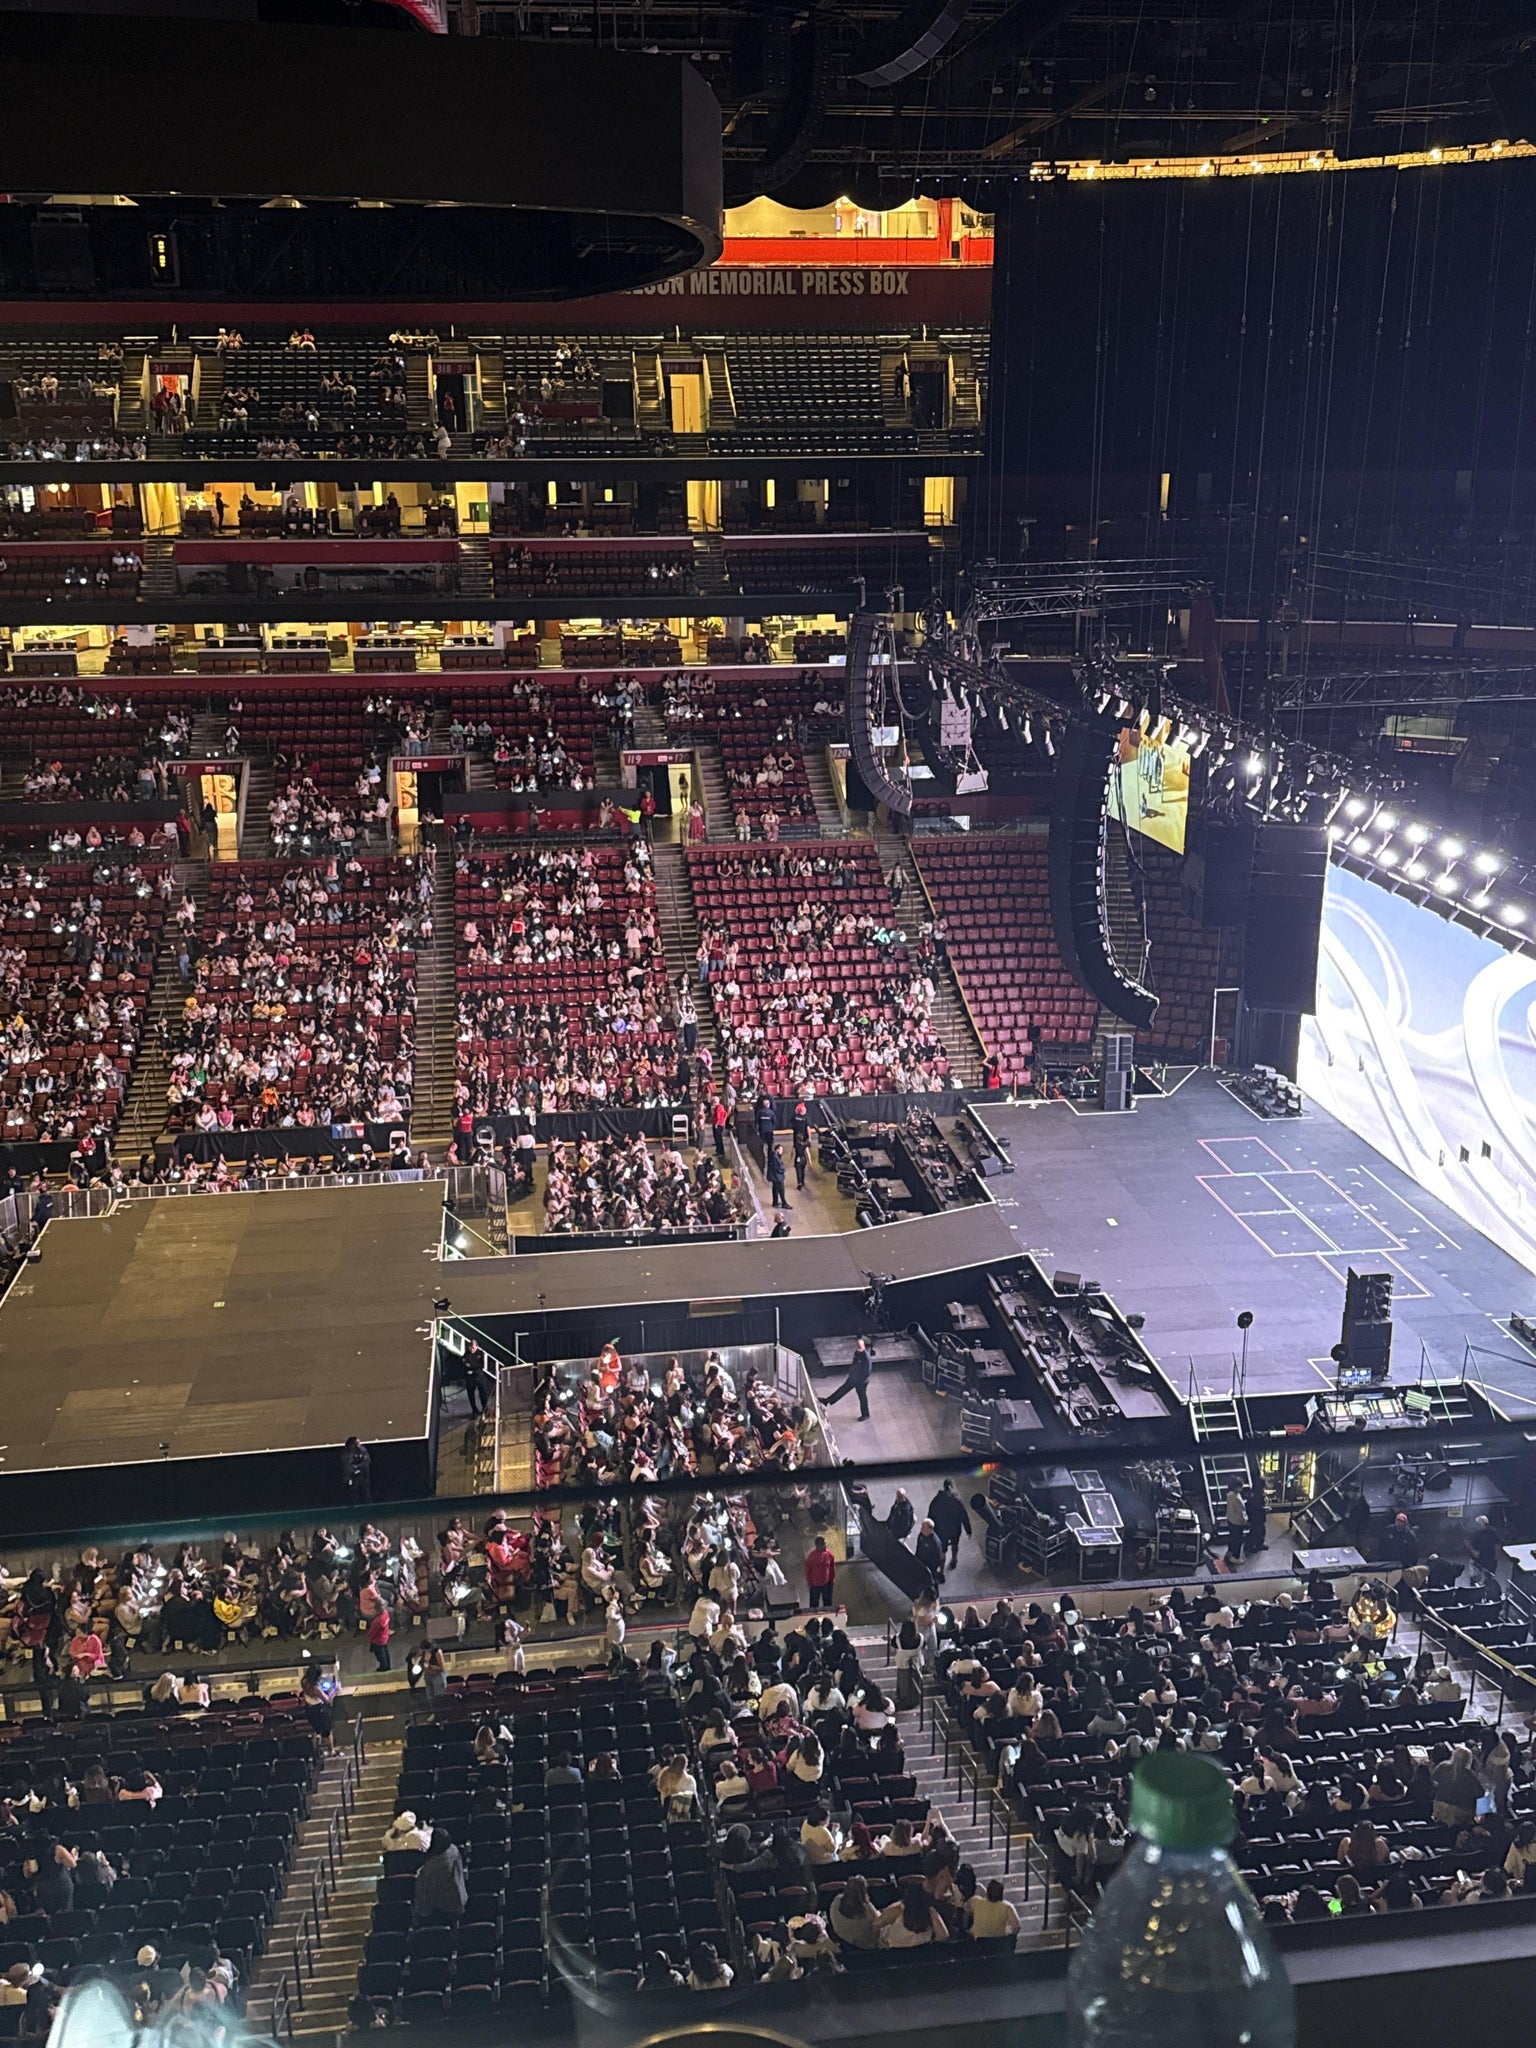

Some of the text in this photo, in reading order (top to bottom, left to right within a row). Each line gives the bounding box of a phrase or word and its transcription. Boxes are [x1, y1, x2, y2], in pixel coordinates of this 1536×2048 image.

[690, 271, 797, 295] MEMORIAL
[802, 271, 865, 295] PRESS
[870, 271, 909, 295] BOX
[153, 364, 169, 373] 317
[437, 364, 452, 374] 318
[665, 364, 679, 373] 319
[834, 748, 848, 757] 120
[628, 755, 642, 764] 119
[675, 753, 689, 763] 120
[172, 765, 188, 775] 117
[397, 761, 411, 771] 118
[447, 759, 462, 769] 119
